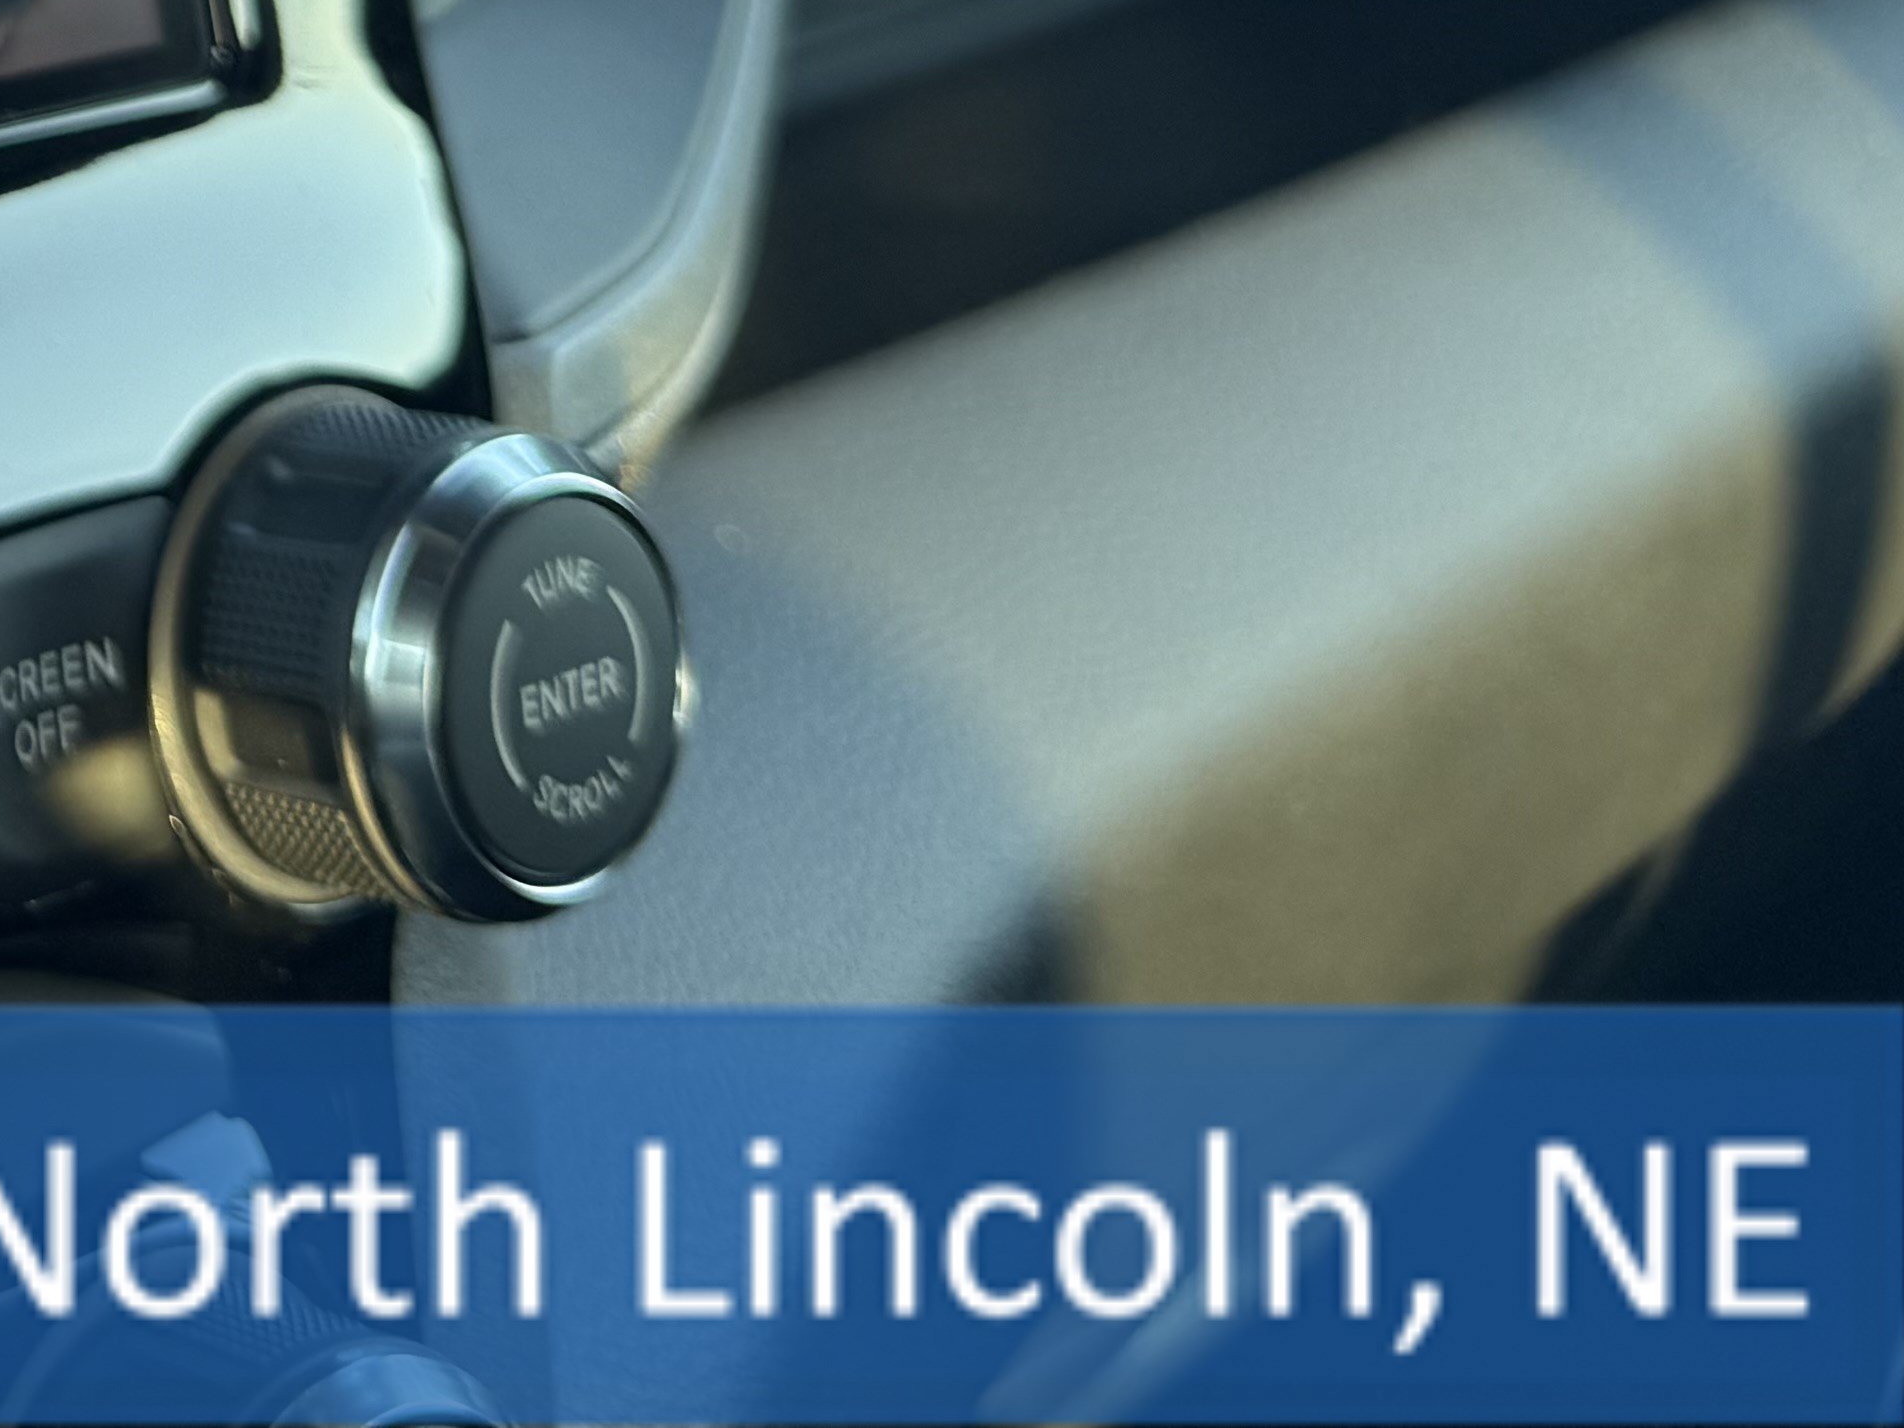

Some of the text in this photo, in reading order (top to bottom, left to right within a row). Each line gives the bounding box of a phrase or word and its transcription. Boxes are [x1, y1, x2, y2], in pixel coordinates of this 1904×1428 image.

[521, 555, 599, 610] TUNE
[519, 656, 625, 730] ENTER
[14, 704, 81, 771] OFF
[533, 755, 632, 824] SCROLL
